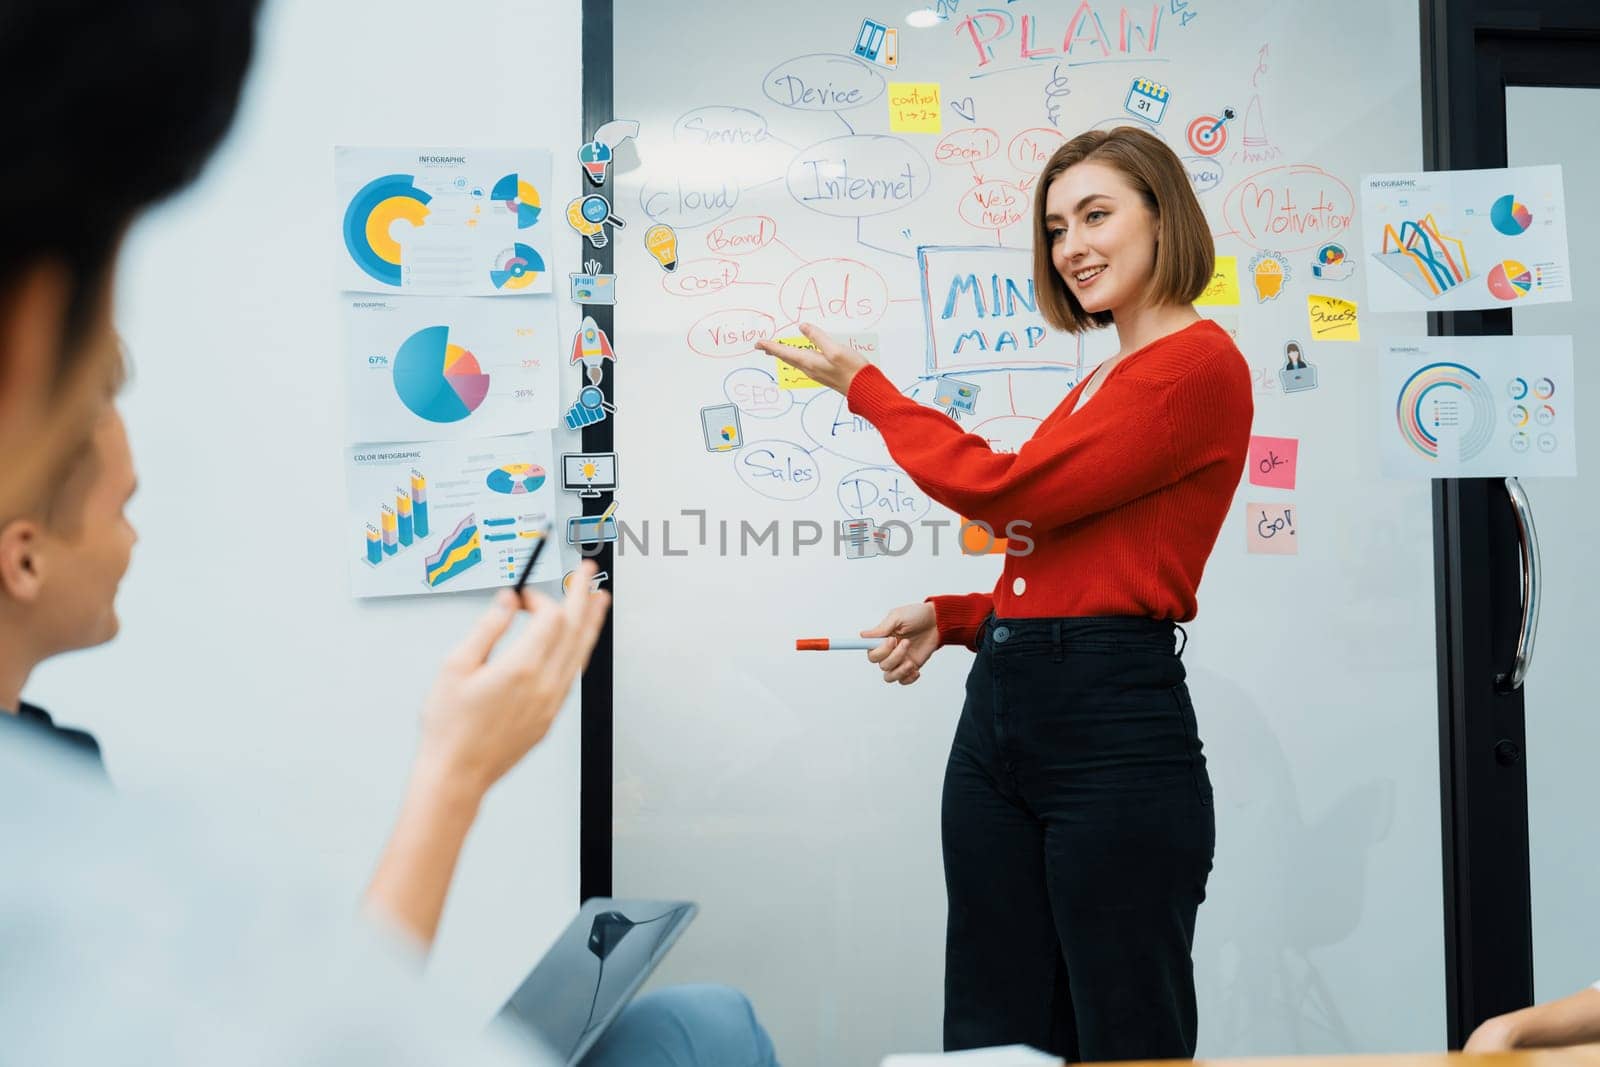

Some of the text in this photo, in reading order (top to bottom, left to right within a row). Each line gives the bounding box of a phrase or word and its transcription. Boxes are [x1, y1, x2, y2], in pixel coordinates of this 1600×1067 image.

[955, 1, 1163, 66] PLAN
[775, 75, 863, 105] Device
[1137, 99, 1151, 112] 31
[803, 159, 916, 201] Internet
[1369, 180, 1416, 188] INFOGRAPHIC
[1241, 183, 1350, 239] Motivation
[711, 220, 765, 250] Brand
[797, 273, 873, 318] Ads
[941, 273, 1037, 319] MIN
[708, 327, 767, 346] Vision
[953, 326, 1046, 354] MAP
[368, 355, 388, 364] 67%
[354, 451, 421, 462] COLOR INFOGRAPHIC
[744, 450, 813, 482] Sales
[842, 478, 916, 516] Data
